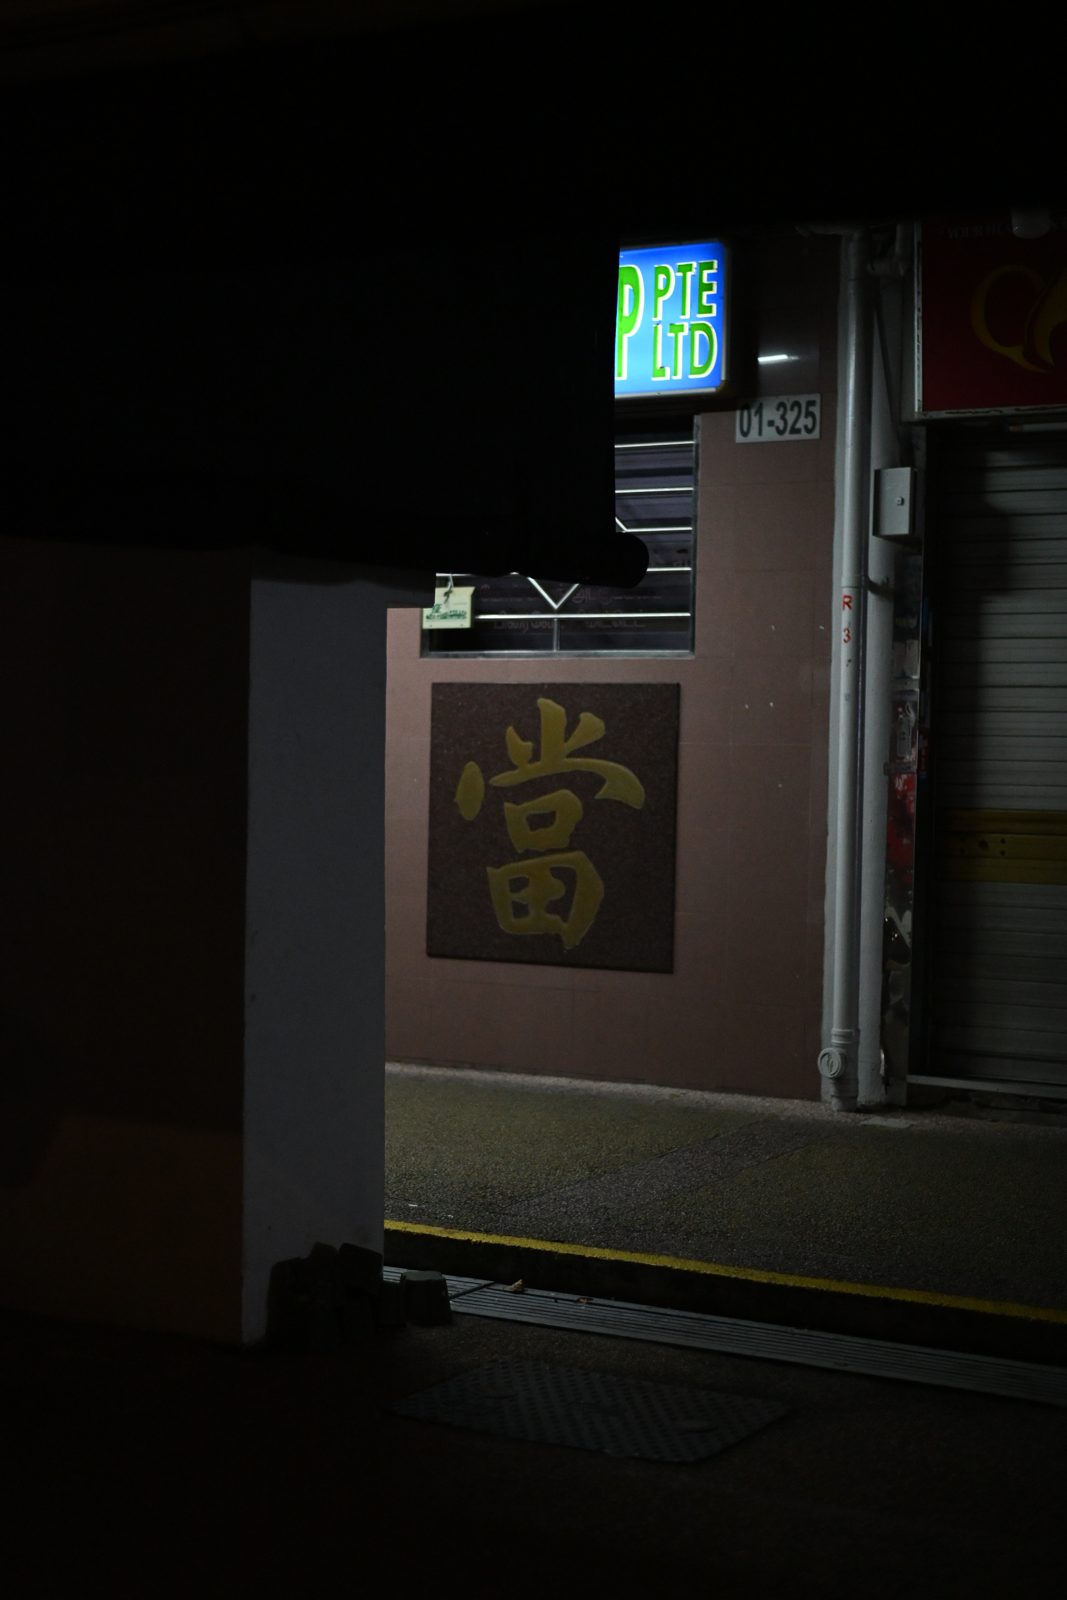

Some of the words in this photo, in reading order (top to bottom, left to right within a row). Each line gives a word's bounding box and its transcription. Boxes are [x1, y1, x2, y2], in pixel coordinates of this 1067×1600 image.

[652, 260, 719, 321] PTE
[651, 321, 719, 381] LTD
[739, 400, 818, 438] 01-325
[842, 594, 853, 610] R
[842, 627, 852, 644] 3
[455, 697, 646, 951] 當
